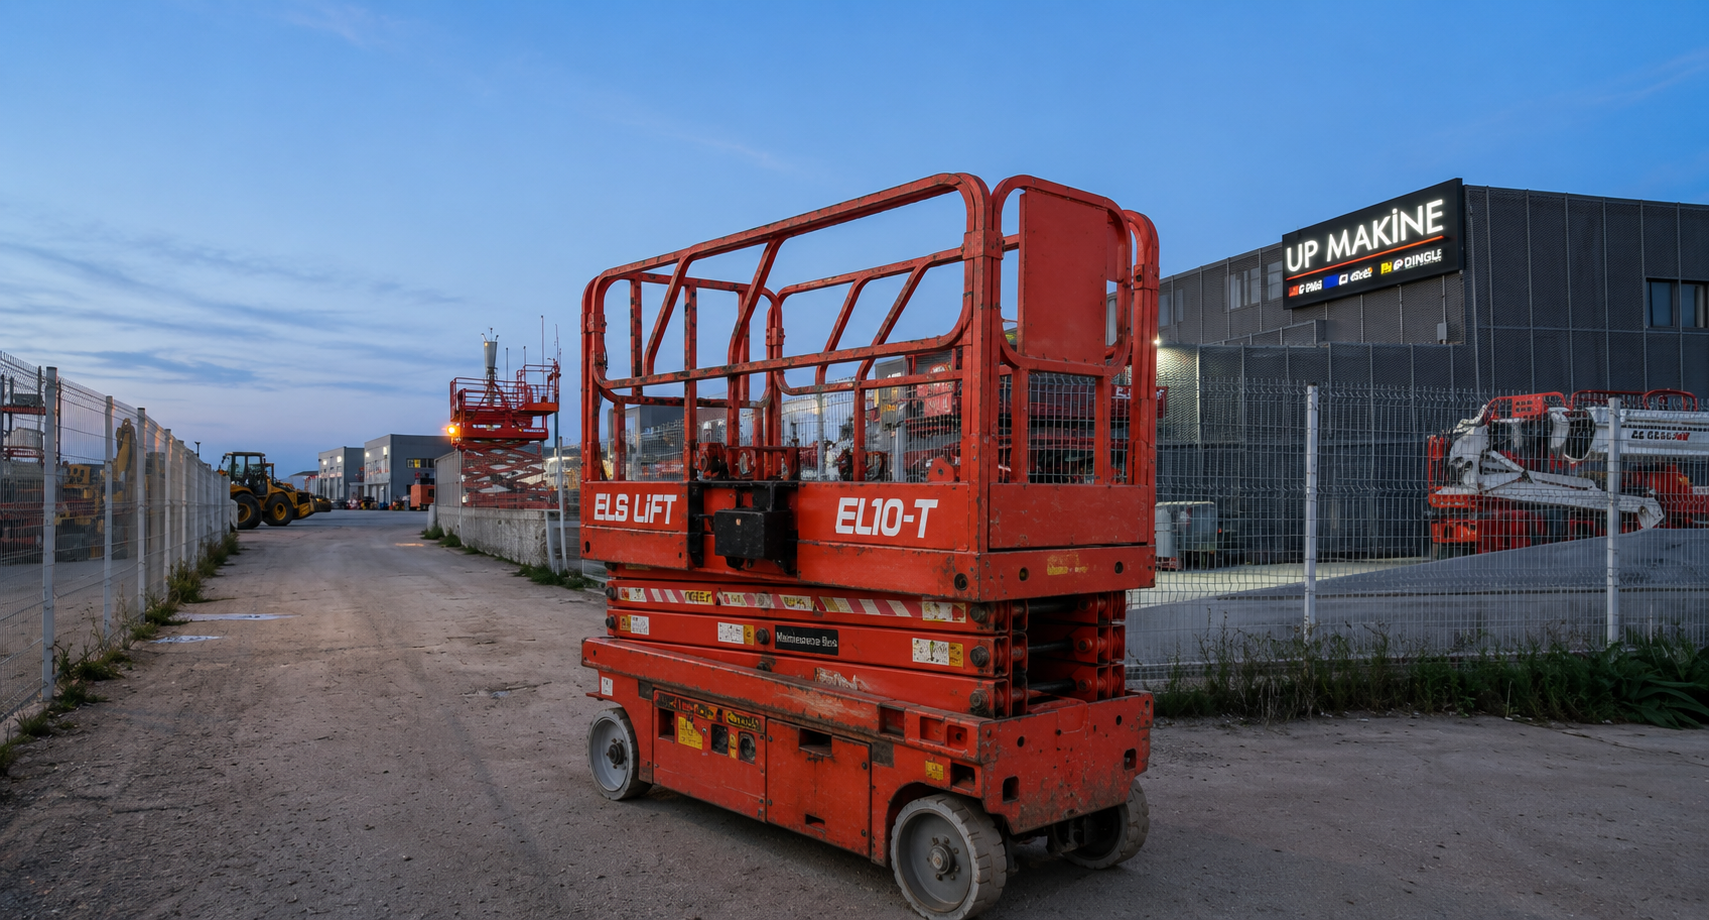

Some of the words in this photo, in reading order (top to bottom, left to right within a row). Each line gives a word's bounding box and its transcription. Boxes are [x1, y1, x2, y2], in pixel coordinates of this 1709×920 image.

[1286, 240, 1319, 272] UP
[1404, 248, 1442, 267] DINGLE
[594, 493, 629, 522] ELS
[835, 497, 939, 539] EL10-T
